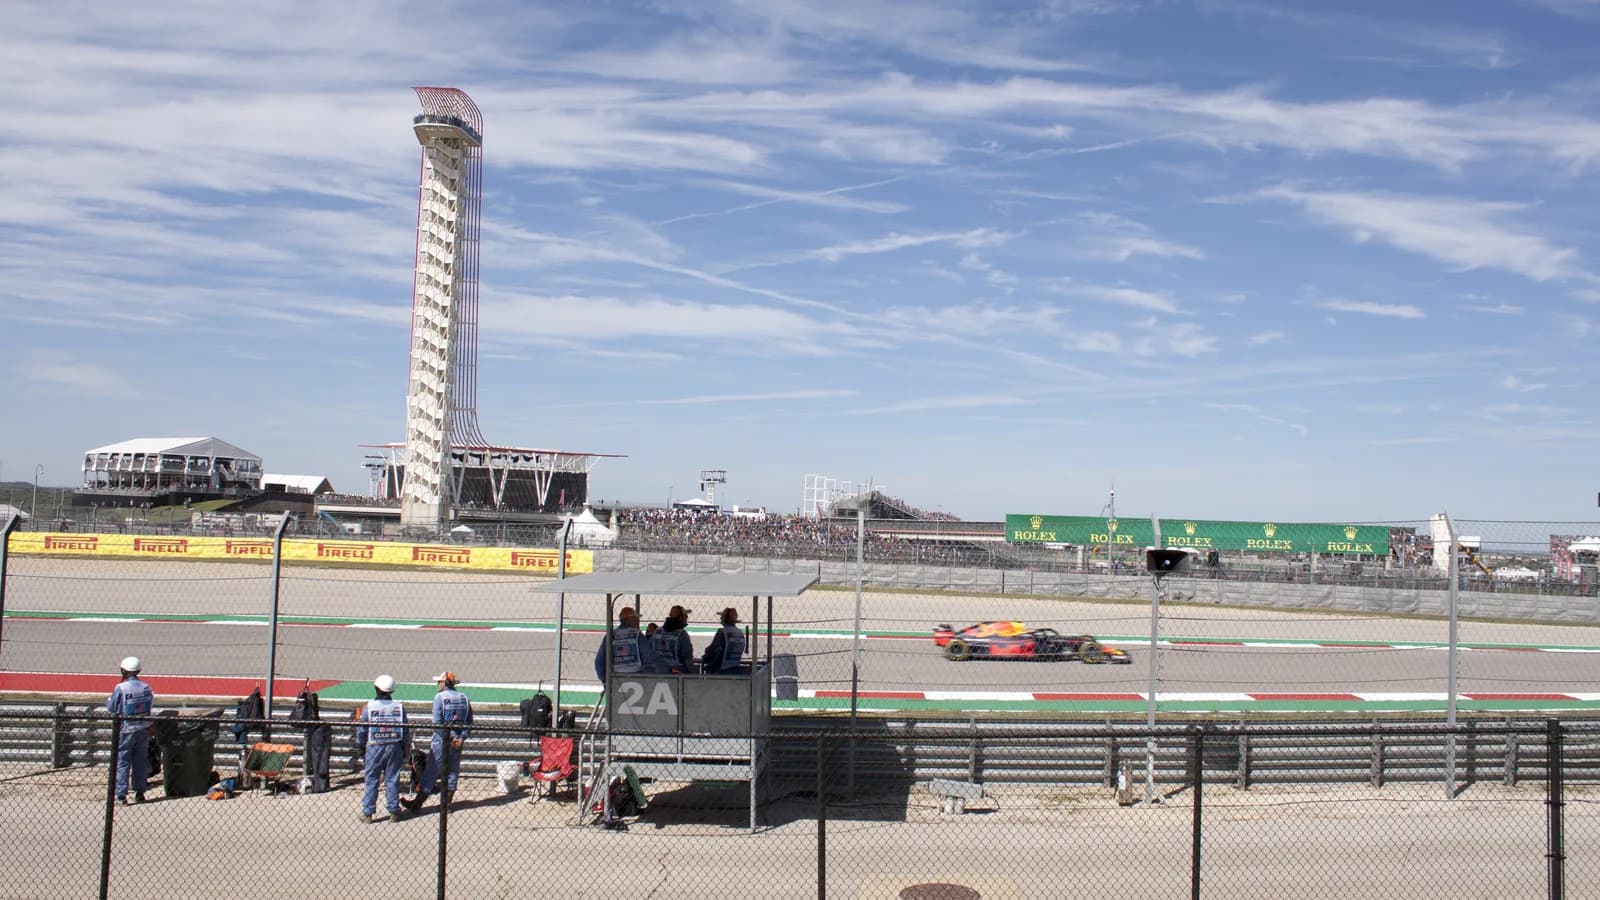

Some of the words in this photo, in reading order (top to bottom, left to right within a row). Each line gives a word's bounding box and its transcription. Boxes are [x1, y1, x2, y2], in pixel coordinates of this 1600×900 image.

[44, 535, 98, 550] PIRELLI
[1014, 530, 1057, 541] ROLEX
[1168, 536, 1212, 547] ROLEX
[134, 538, 188, 553] PIRELLI
[226, 540, 274, 555] PIRELL
[317, 543, 374, 559] PIRELLI
[1247, 539, 1292, 550] ROLEX
[1327, 542, 1373, 553] ROLEX
[412, 546, 471, 564] PIRELLI
[511, 551, 572, 568] PIRELI
[617, 681, 678, 715] 2A
